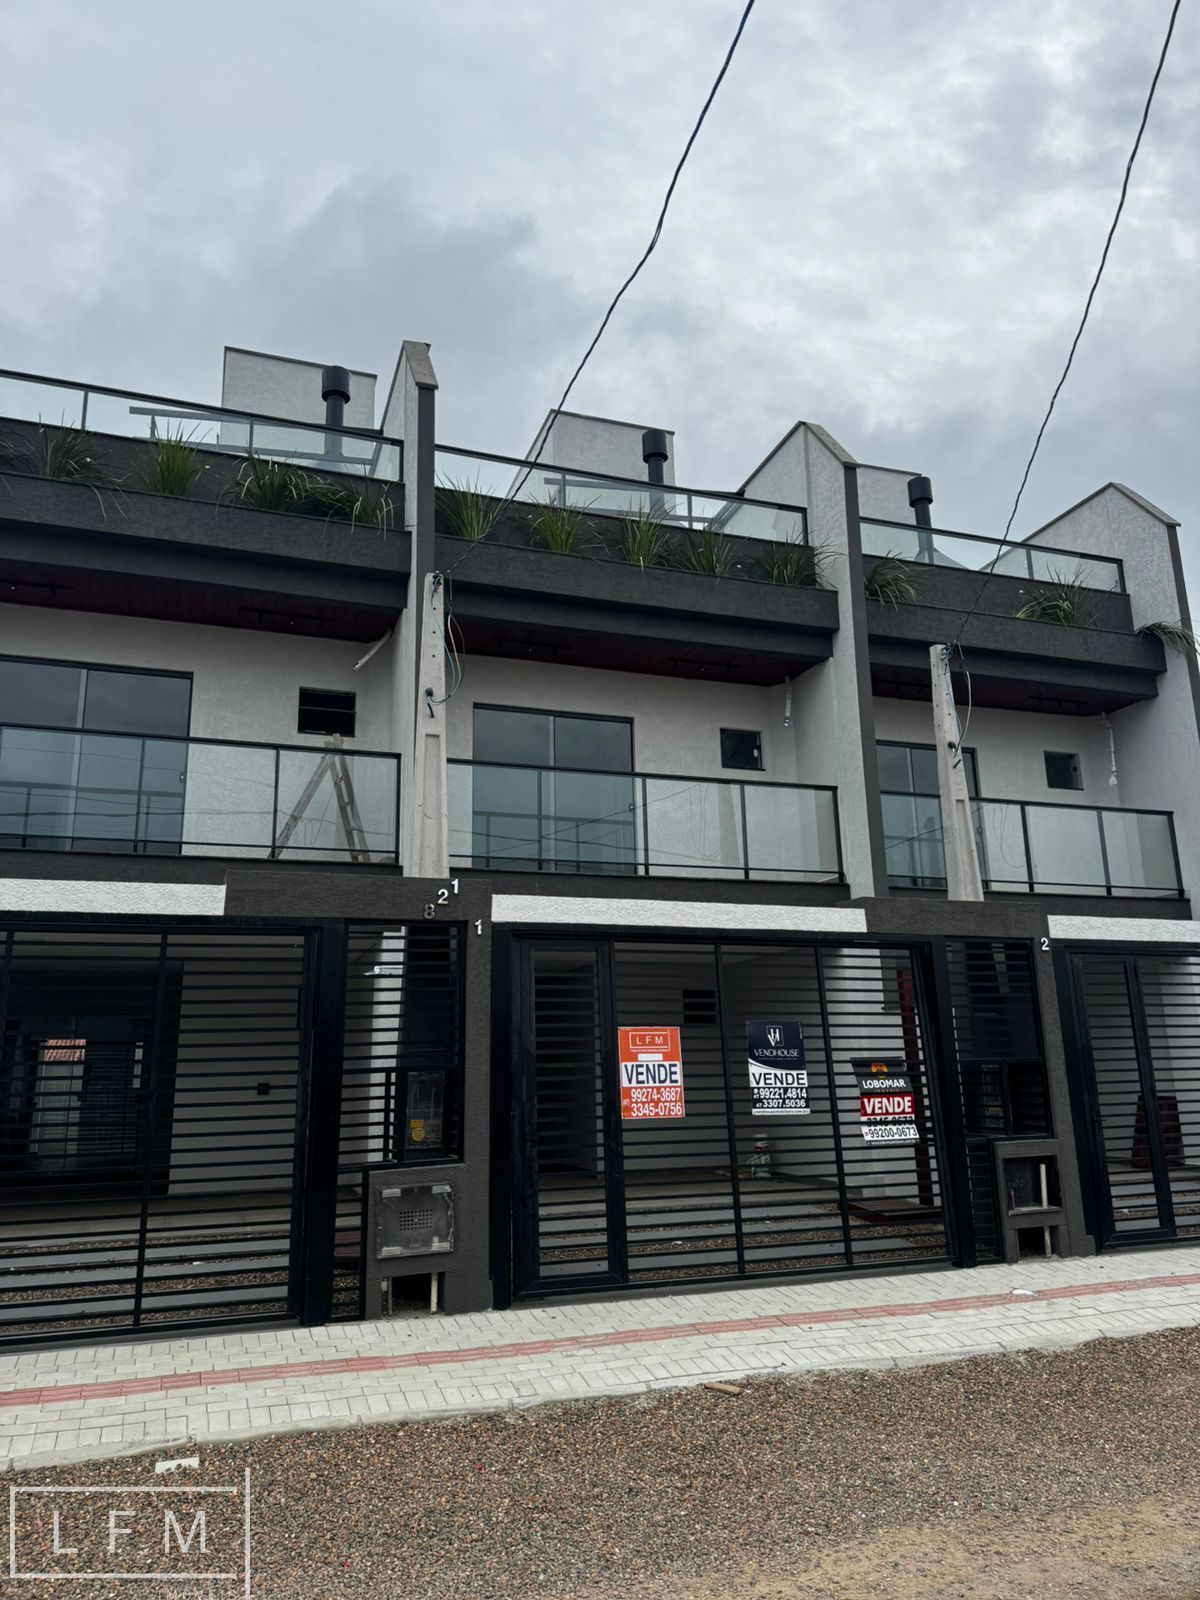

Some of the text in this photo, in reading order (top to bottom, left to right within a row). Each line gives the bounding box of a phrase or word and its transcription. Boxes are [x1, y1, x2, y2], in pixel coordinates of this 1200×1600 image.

[475, 920, 482, 935] 1
[1041, 937, 1050, 951] 2
[754, 1048, 800, 1057] VENDHOUSE
[624, 1063, 679, 1085] VENDE
[752, 1072, 806, 1086] VENDE
[861, 1079, 906, 1089] LOBOMAR
[631, 1087, 681, 1102] 99274-3687
[759, 1087, 807, 1099] 99221.4814
[631, 1102, 682, 1117] 3345-0756
[762, 1099, 806, 1108] 3307.5036
[863, 1096, 912, 1114] VENDE
[868, 1126, 917, 1138] 99200-0673
